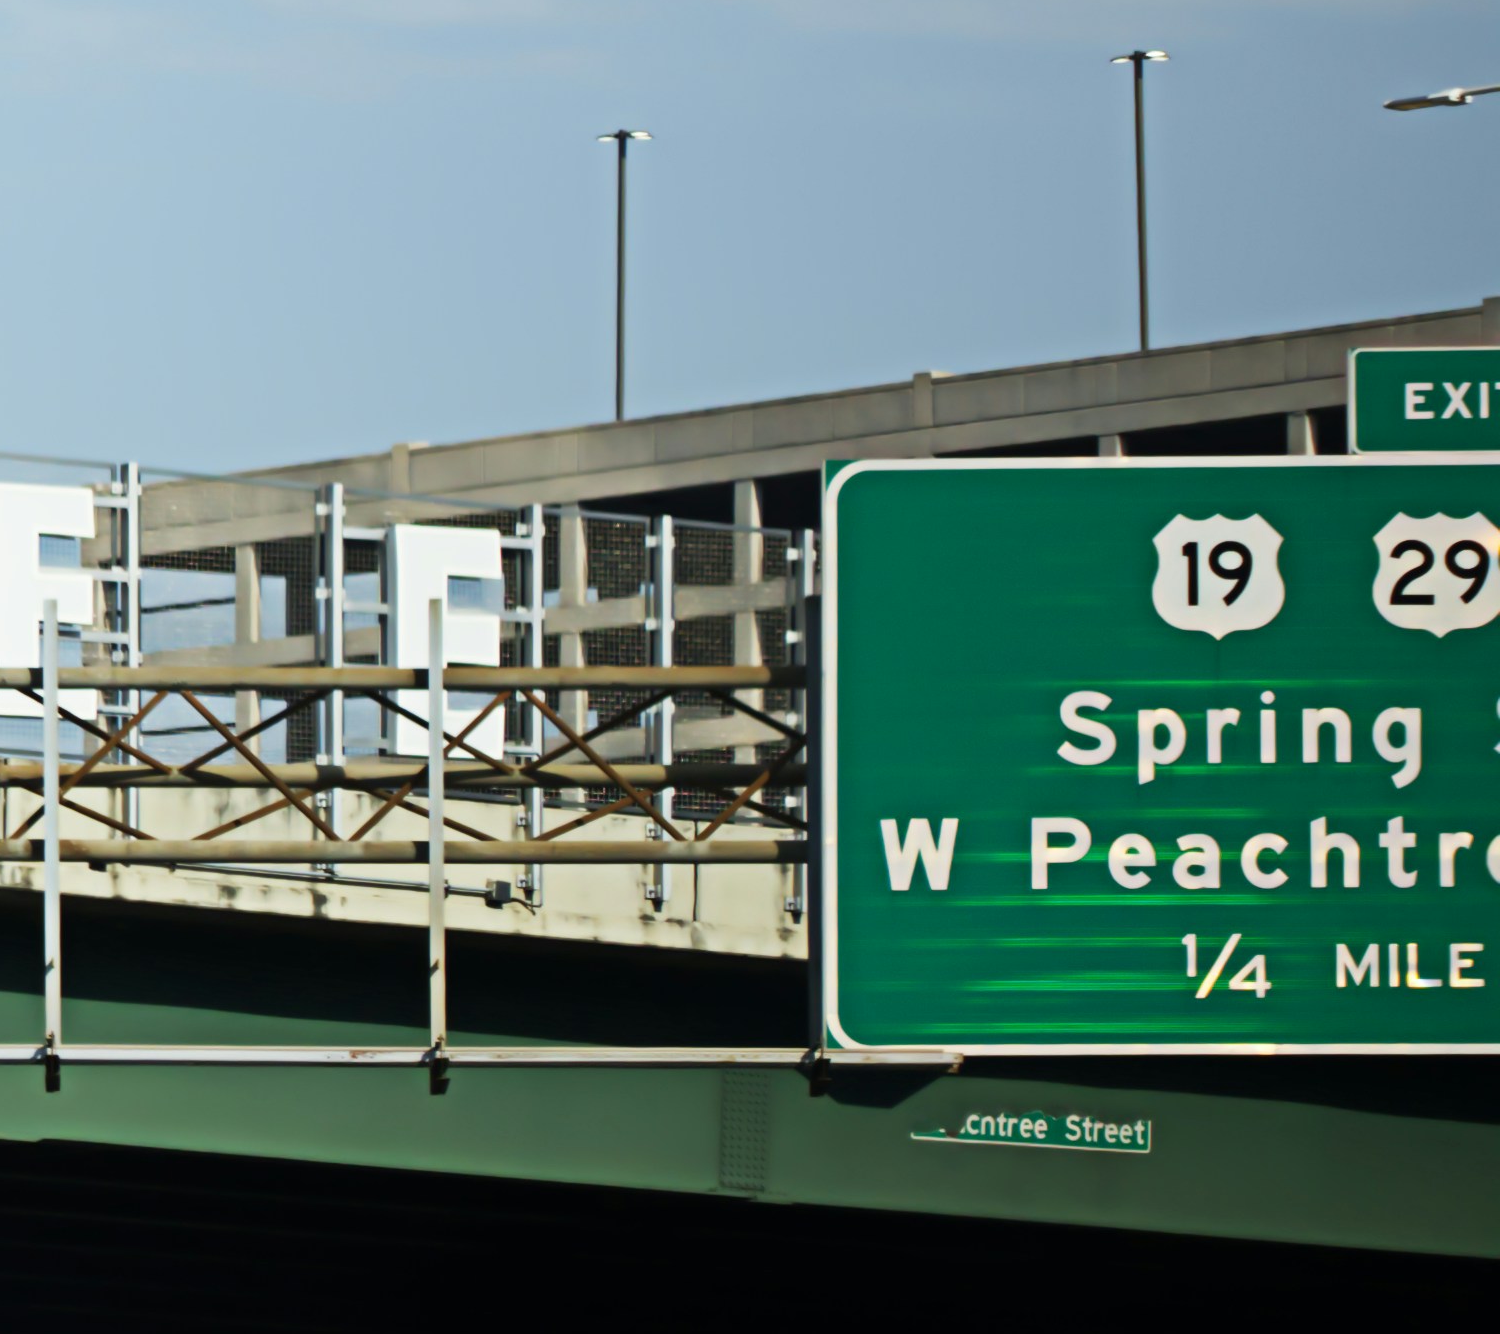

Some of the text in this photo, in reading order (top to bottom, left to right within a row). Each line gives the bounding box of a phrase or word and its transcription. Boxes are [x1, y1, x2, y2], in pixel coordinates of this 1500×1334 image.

[1405, 381, 1500, 420] EXI
[1182, 539, 1491, 607] 19 29
[1056, 689, 1423, 789] Spring
[880, 817, 959, 891] W
[1335, 942, 1486, 989] MILE
[1064, 1114, 1146, 1145] Street
